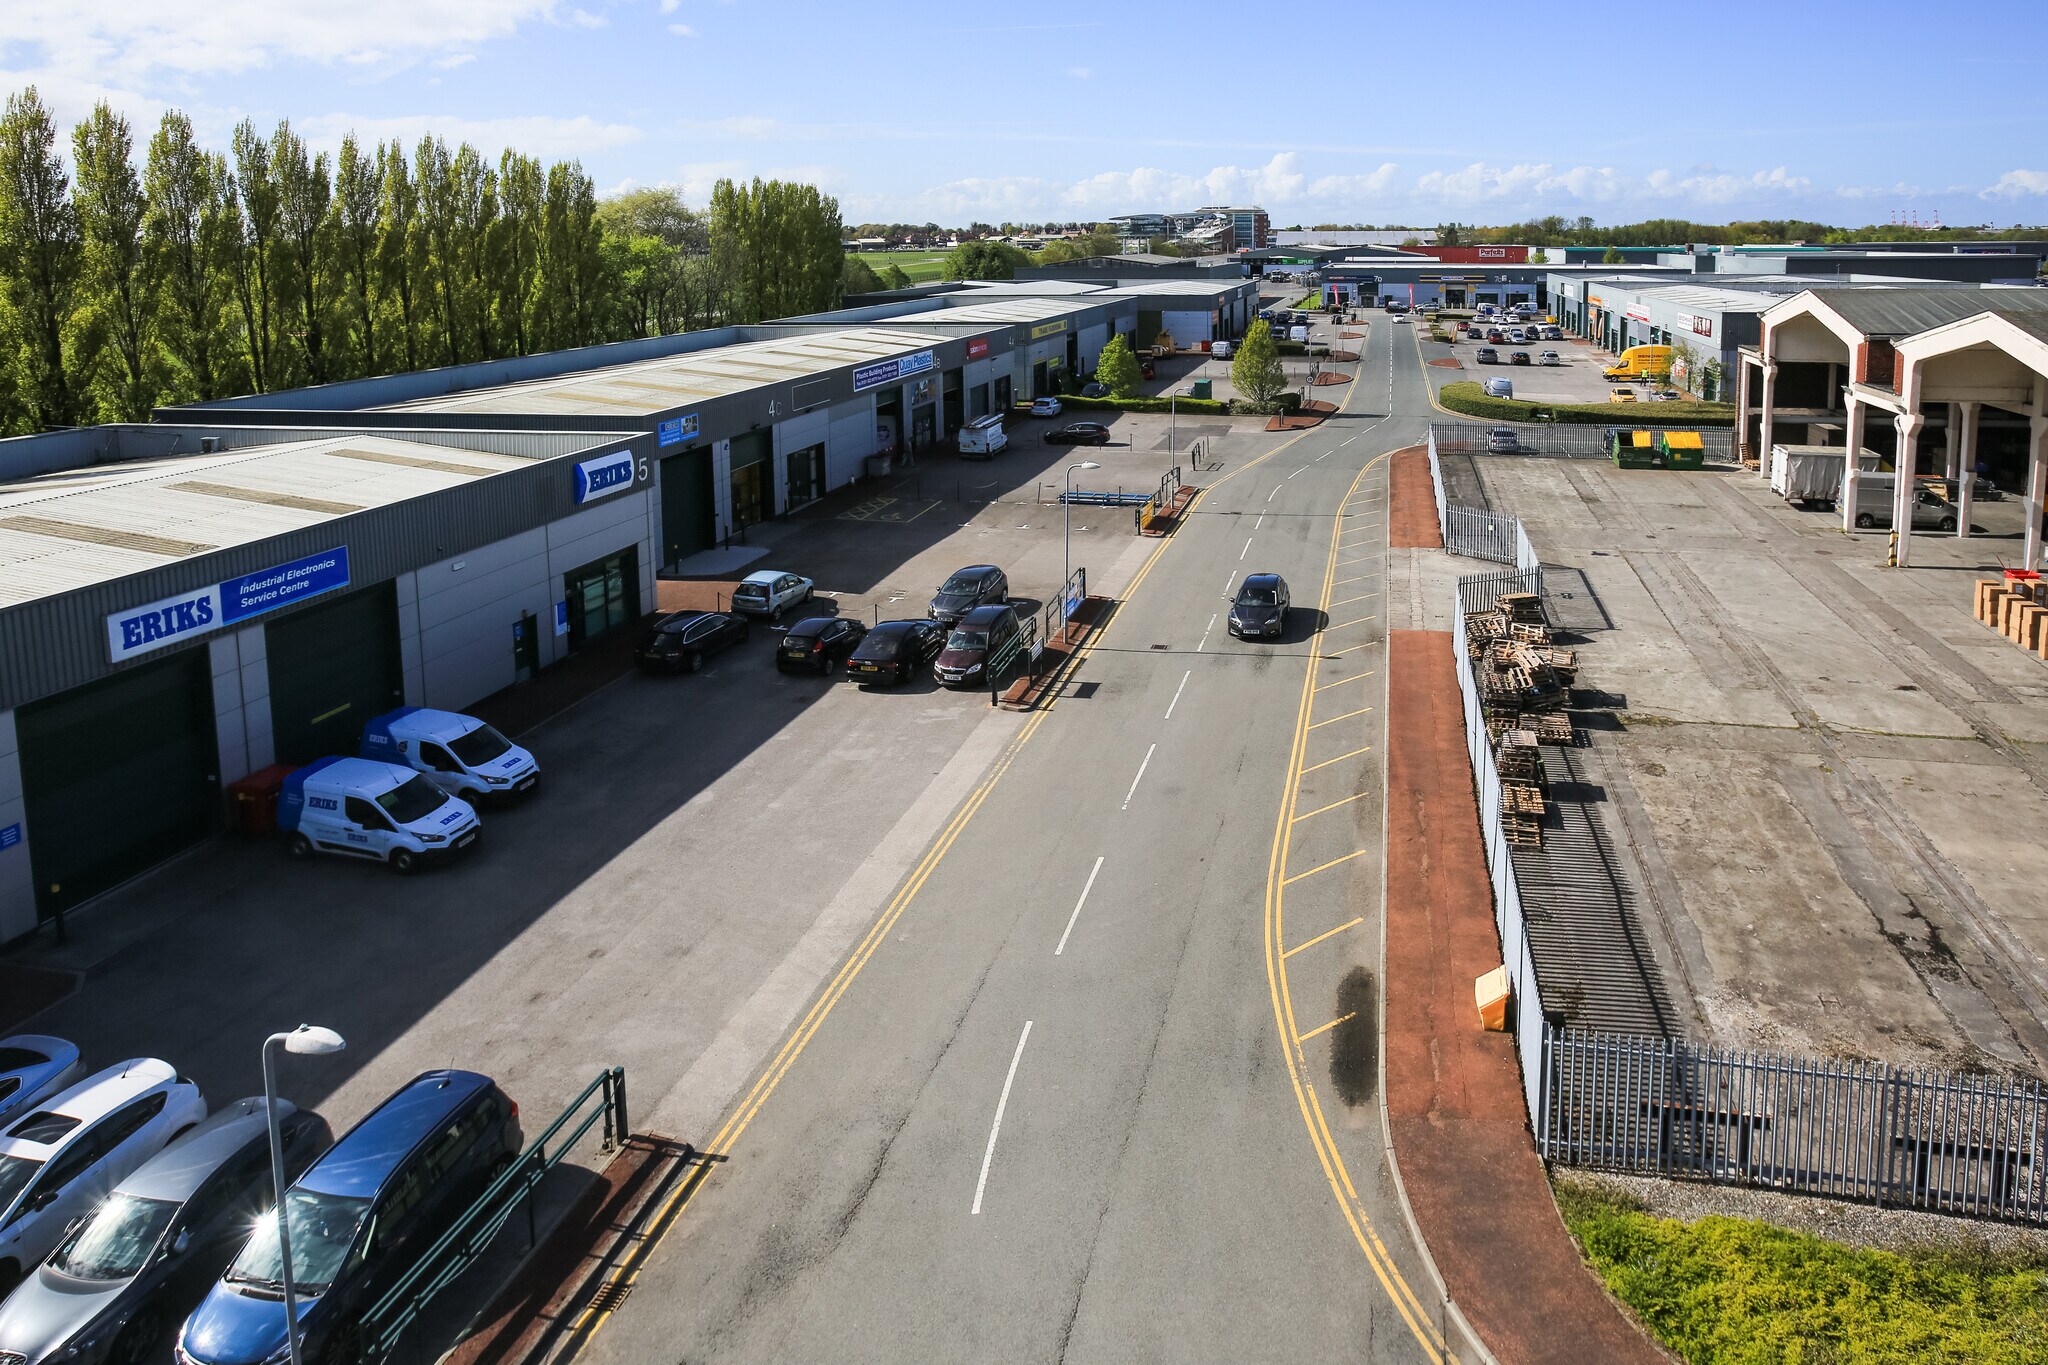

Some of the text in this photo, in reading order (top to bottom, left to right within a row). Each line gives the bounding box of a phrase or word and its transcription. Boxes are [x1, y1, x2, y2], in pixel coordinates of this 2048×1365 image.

[900, 353, 932, 370] Quay Plastics
[933, 356, 941, 369] 4B
[856, 371, 869, 380] Plastic
[869, 367, 882, 377] Building
[882, 364, 897, 373] Products
[588, 460, 632, 493] ERIKS
[638, 457, 648, 481] 5
[240, 559, 335, 595] Industrial Electronics
[241, 579, 309, 608] Service Centre
[120, 595, 213, 650] ERIKS
[369, 734, 388, 744] ERIKS
[308, 796, 338, 811] ERIKS
[440, 811, 462, 826] ERIKS
[347, 833, 368, 843] ERIKS
